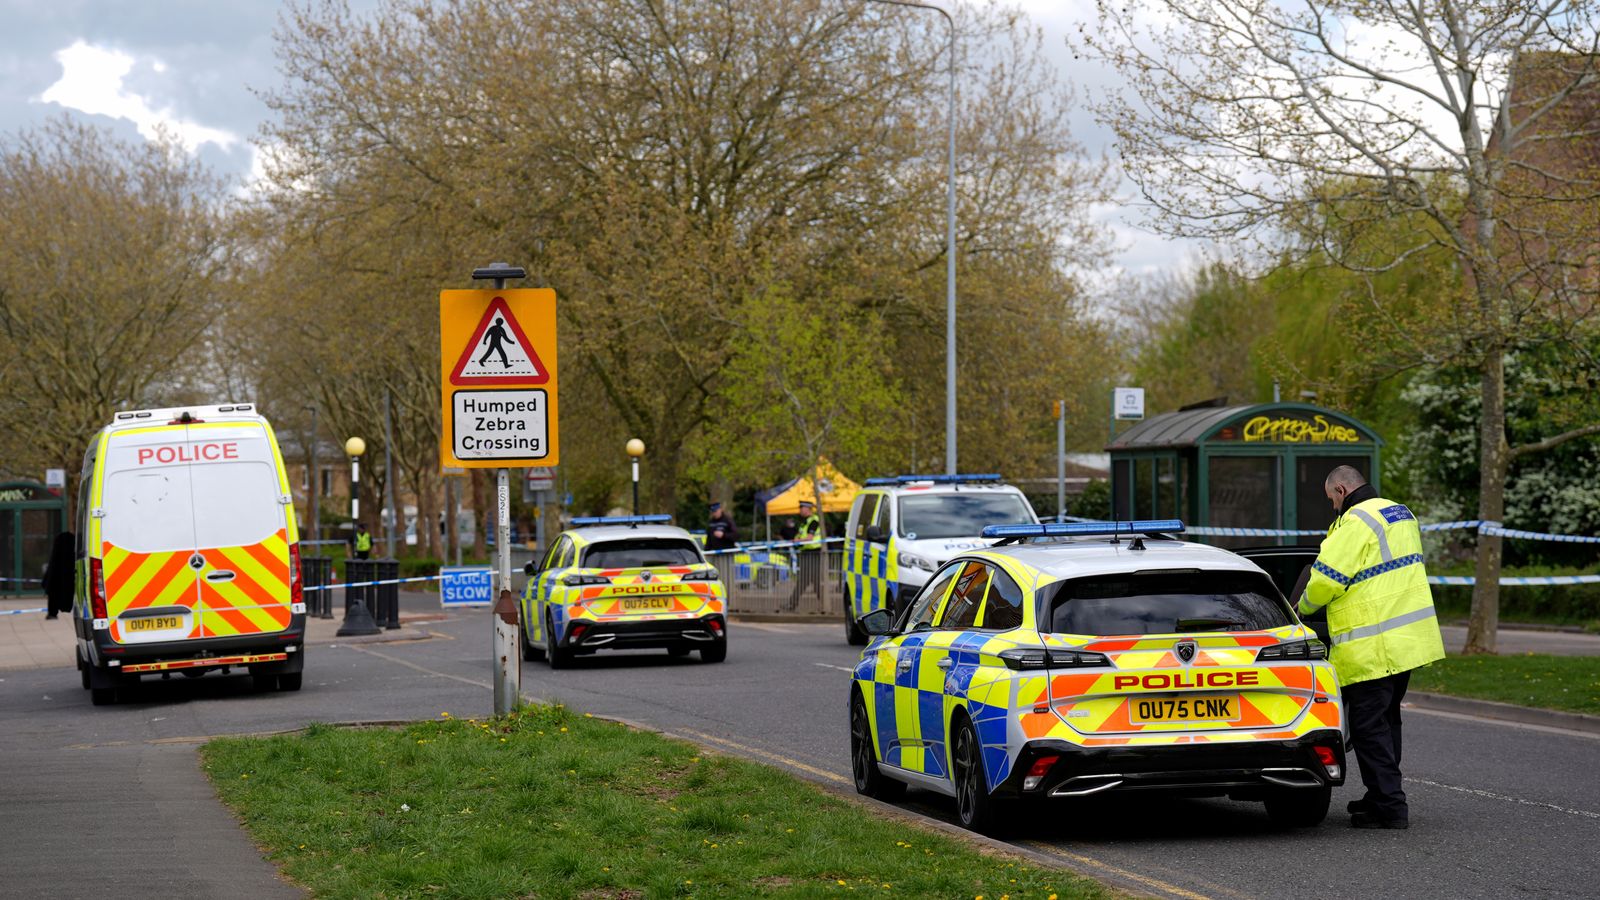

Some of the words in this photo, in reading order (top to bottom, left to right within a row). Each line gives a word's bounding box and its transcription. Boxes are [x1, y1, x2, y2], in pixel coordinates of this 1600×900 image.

[463, 398, 537, 414] Humped
[475, 417, 526, 431] Zebra
[462, 435, 540, 451] Crossing
[138, 443, 239, 464] POLICE
[944, 543, 992, 551] POLI
[445, 573, 488, 585] POLICE
[446, 586, 489, 600] SLOW
[612, 585, 682, 594] POLICE
[624, 599, 649, 609] OU75
[650, 598, 669, 608] CLV
[156, 617, 177, 628] BYD
[1114, 671, 1259, 690] POLICE
[1139, 700, 1189, 719] OU75
[1193, 699, 1231, 718] CNK
